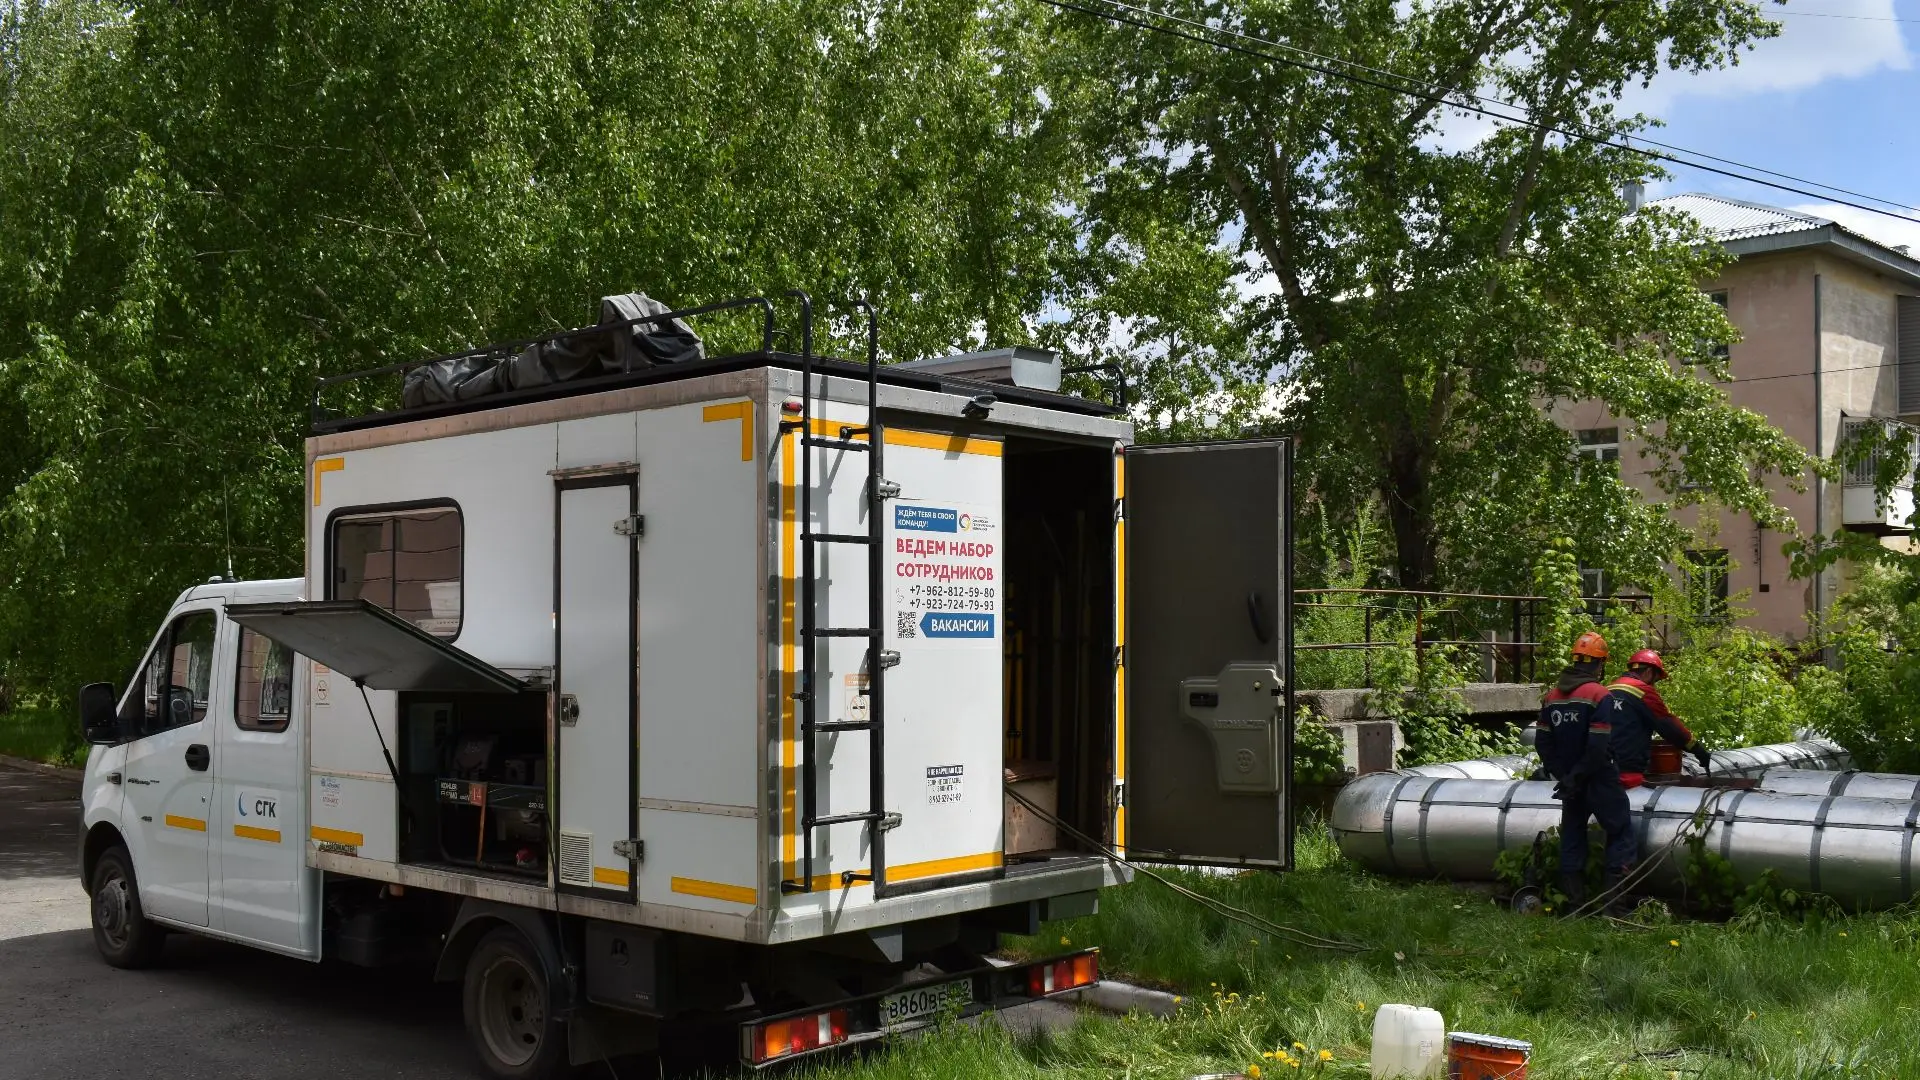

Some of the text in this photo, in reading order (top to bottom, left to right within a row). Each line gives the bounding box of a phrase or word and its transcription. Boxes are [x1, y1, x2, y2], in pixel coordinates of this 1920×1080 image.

[918, 511, 932, 519] ТЕБЯ
[897, 519, 929, 528] КОМАНДУ!
[896, 538, 994, 559] ВЕДЕМ НАБОР
[896, 562, 994, 583] СОТРУДНИКОВ
[910, 585, 995, 598] +7-962-812-59-80
[910, 598, 994, 611] +7-923-724-79-93
[931, 618, 989, 632] ВАКАНСИИ
[255, 799, 276, 818] СГК
